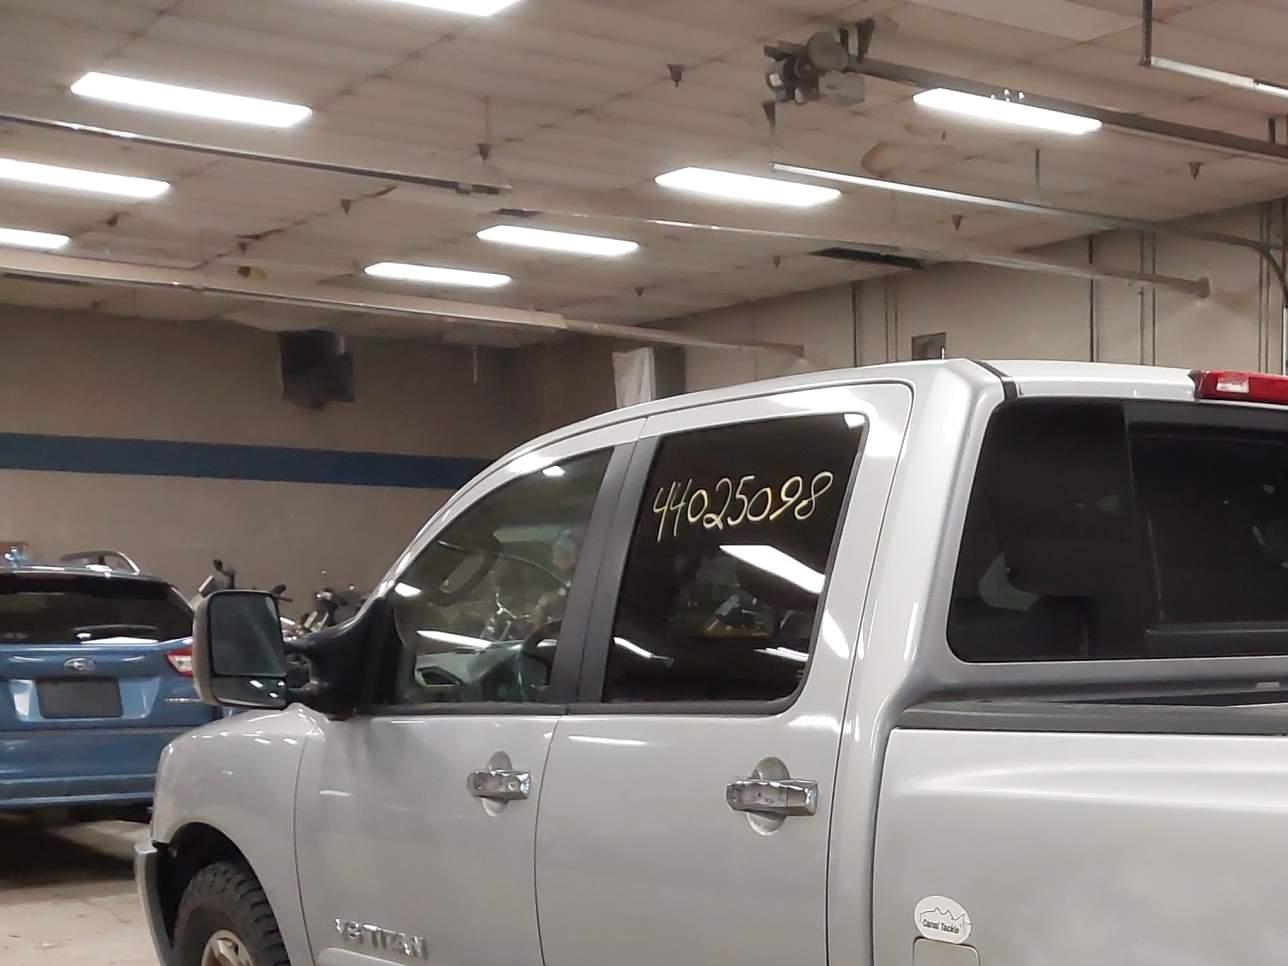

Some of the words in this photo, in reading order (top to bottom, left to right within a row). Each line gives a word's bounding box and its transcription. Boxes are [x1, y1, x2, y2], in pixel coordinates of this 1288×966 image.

[653, 471, 834, 542] 44025098
[363, 923, 428, 960] TITAN
[922, 919, 939, 929] Canal
